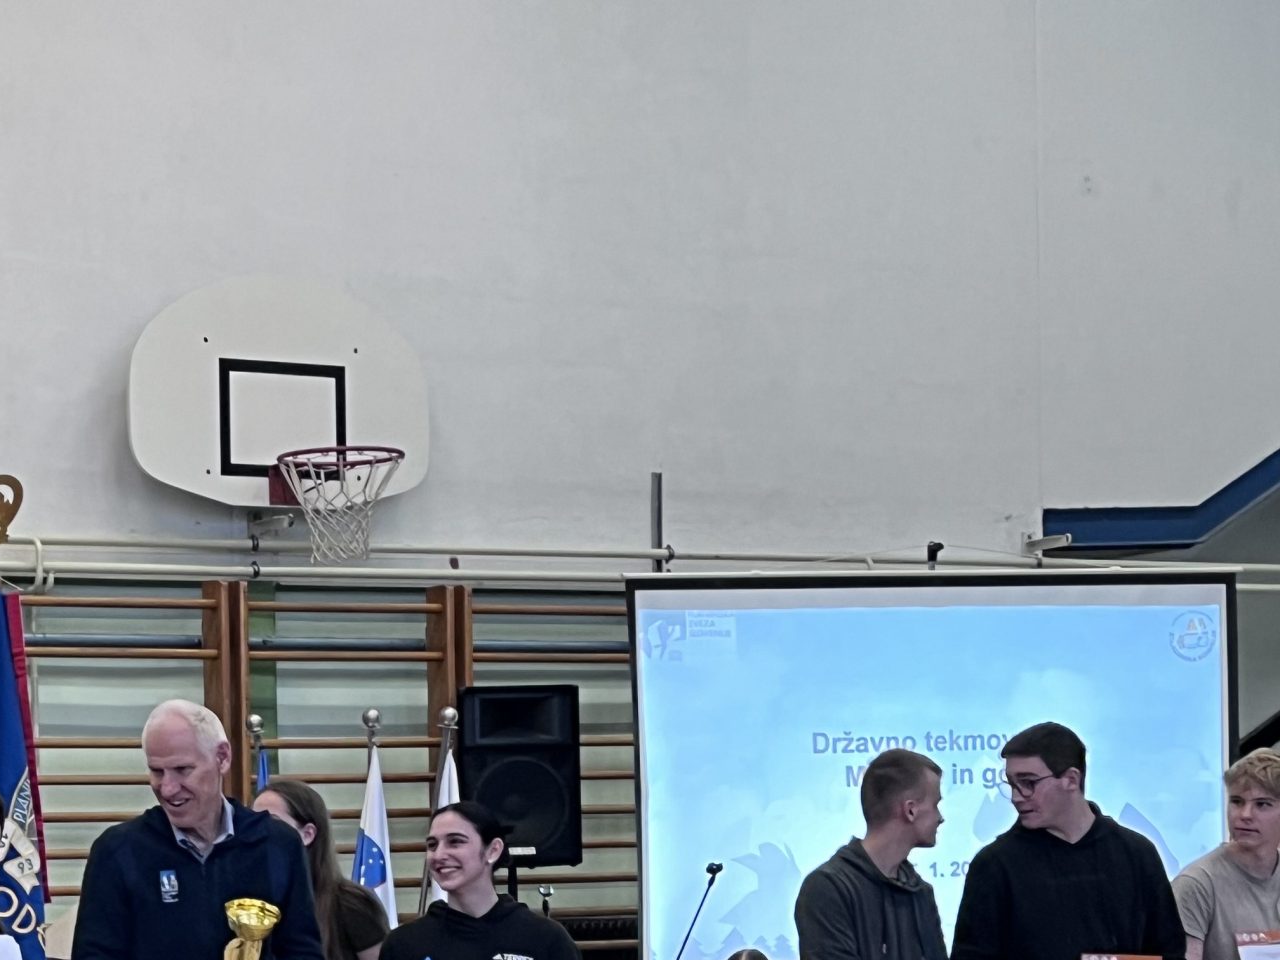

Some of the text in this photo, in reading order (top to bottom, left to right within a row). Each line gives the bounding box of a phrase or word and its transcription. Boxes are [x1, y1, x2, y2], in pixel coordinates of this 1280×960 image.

[812, 730, 1009, 754] Državno tekmo
[952, 764, 1007, 789] in go
[950, 861, 970, 877] 20
